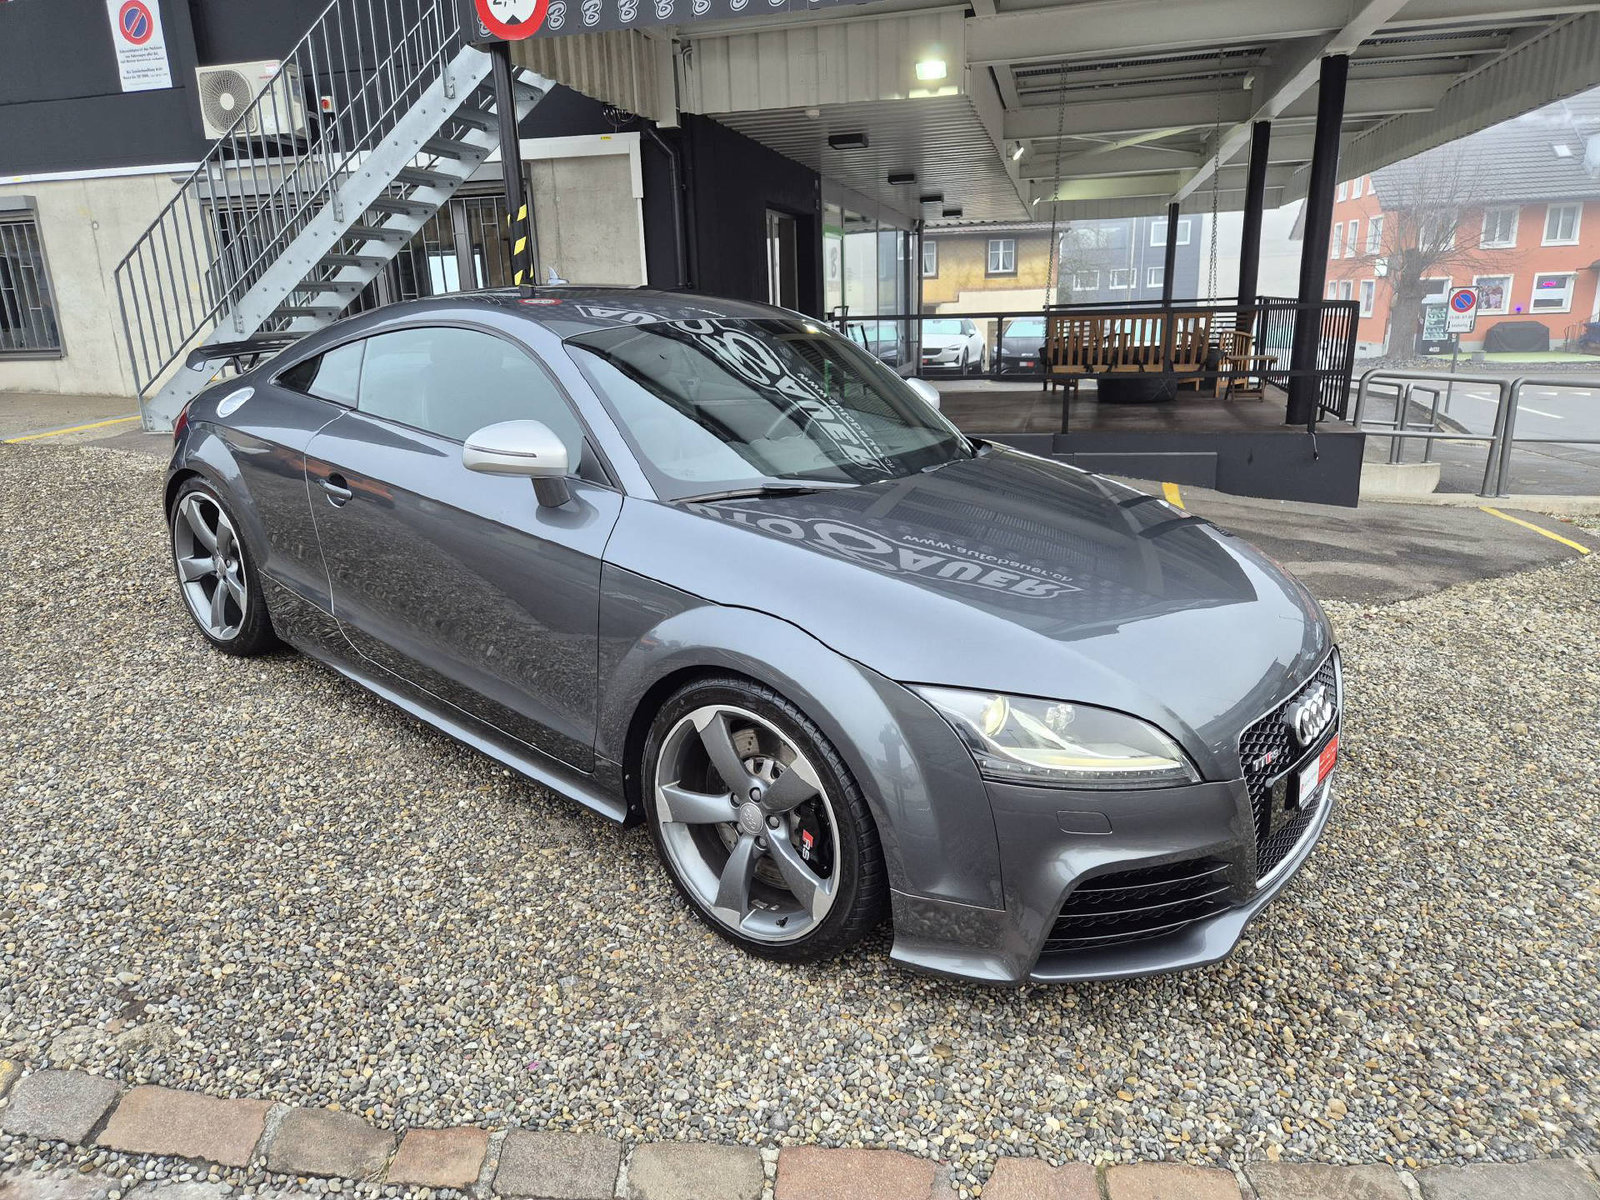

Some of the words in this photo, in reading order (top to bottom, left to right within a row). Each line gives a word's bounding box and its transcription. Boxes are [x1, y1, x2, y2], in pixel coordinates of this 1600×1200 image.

[548, 1, 567, 30] B
[581, 0, 602, 26] B
[803, 834, 814, 860] RS
